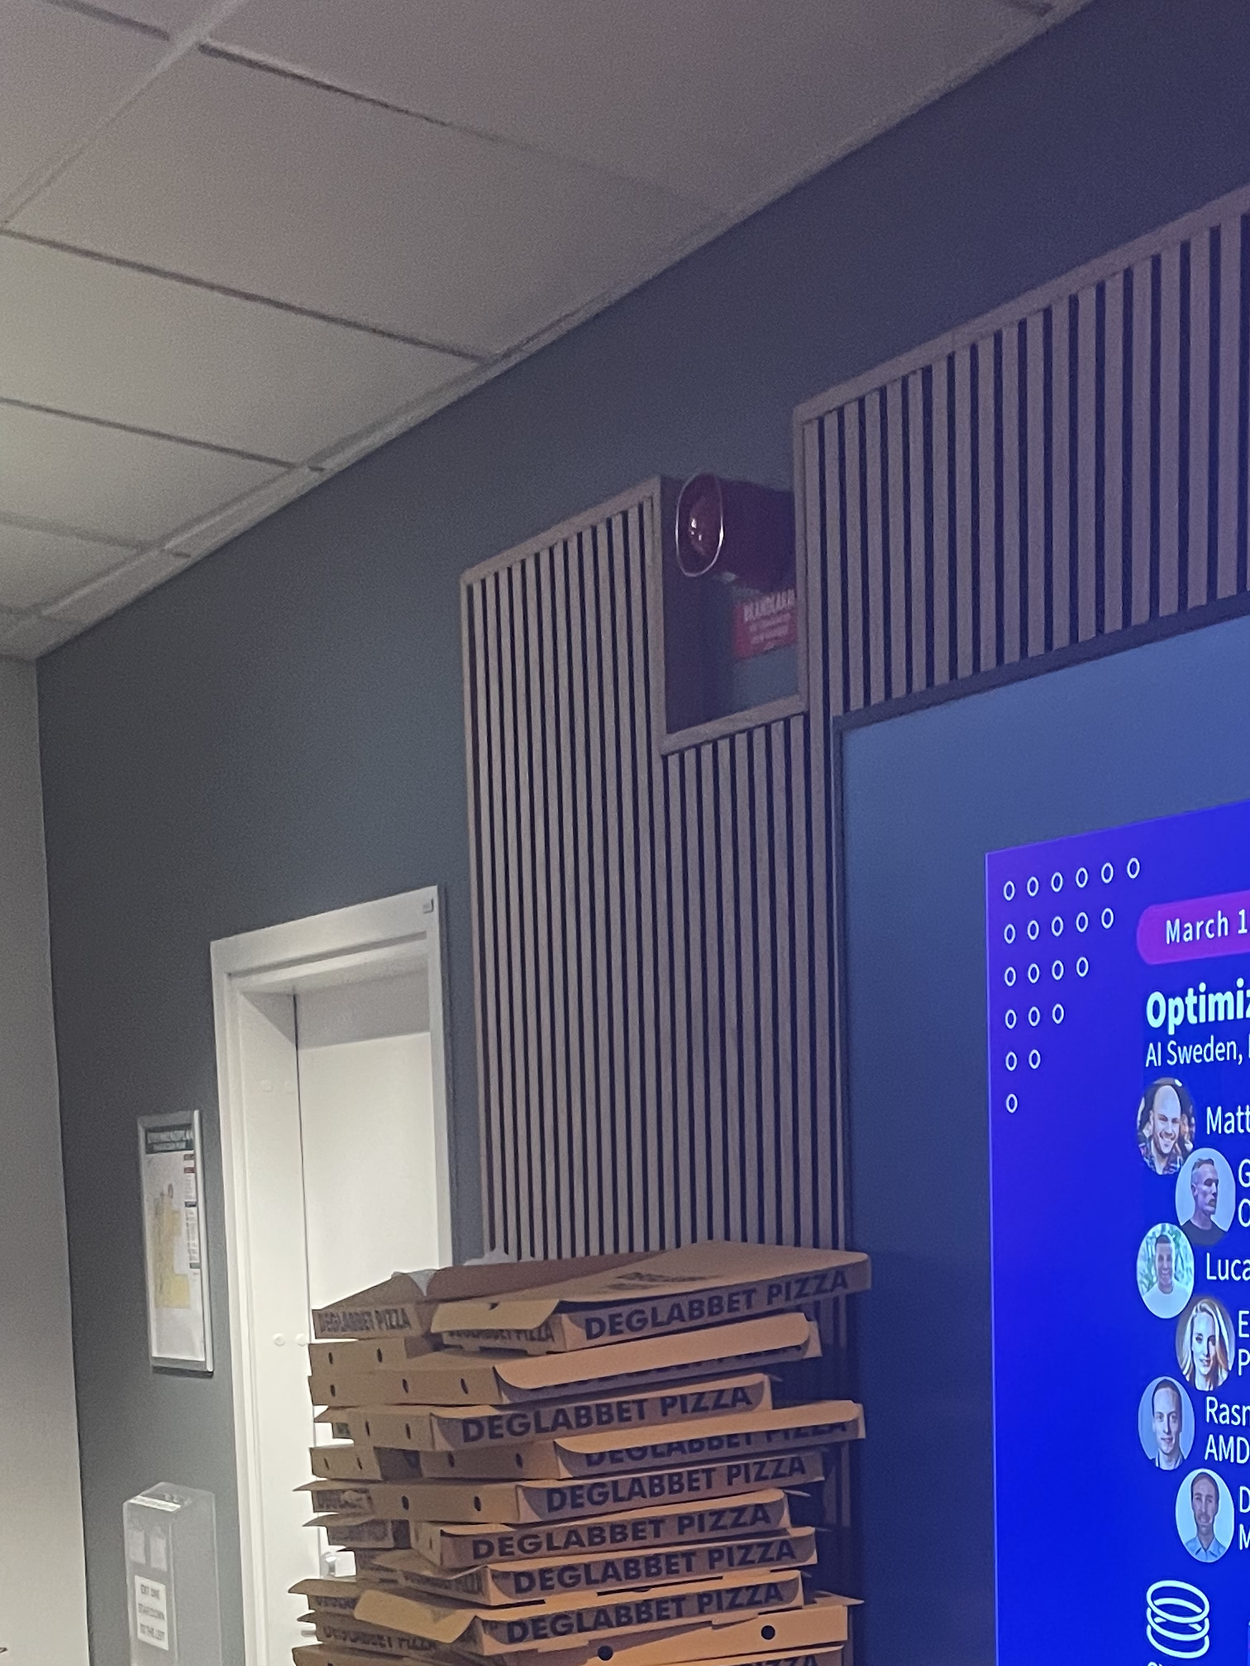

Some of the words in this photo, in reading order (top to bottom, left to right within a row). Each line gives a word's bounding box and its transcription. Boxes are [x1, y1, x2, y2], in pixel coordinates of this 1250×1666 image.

[1165, 909, 1229, 945] March
[1145, 1041, 1162, 1068] AI
[1166, 1034, 1243, 1066] Sweden,
[584, 1288, 757, 1341] DEGLABBET
[767, 1270, 849, 1306] PIZZA
[461, 1397, 649, 1444] DEGLABBET
[660, 1385, 753, 1418] PIZZA
[1204, 1433, 1250, 1465] AMD
[546, 1467, 717, 1514] DEGLABBET
[727, 1456, 807, 1486] PIZZA
[472, 1519, 666, 1560] DEGLABBET
[677, 1504, 771, 1534] PIZZA
[513, 1551, 698, 1595] DEGLABBET
[708, 1539, 797, 1569] PIZZA
[506, 1599, 687, 1644] DEGLABBET
[700, 1583, 784, 1612] PIZZA
